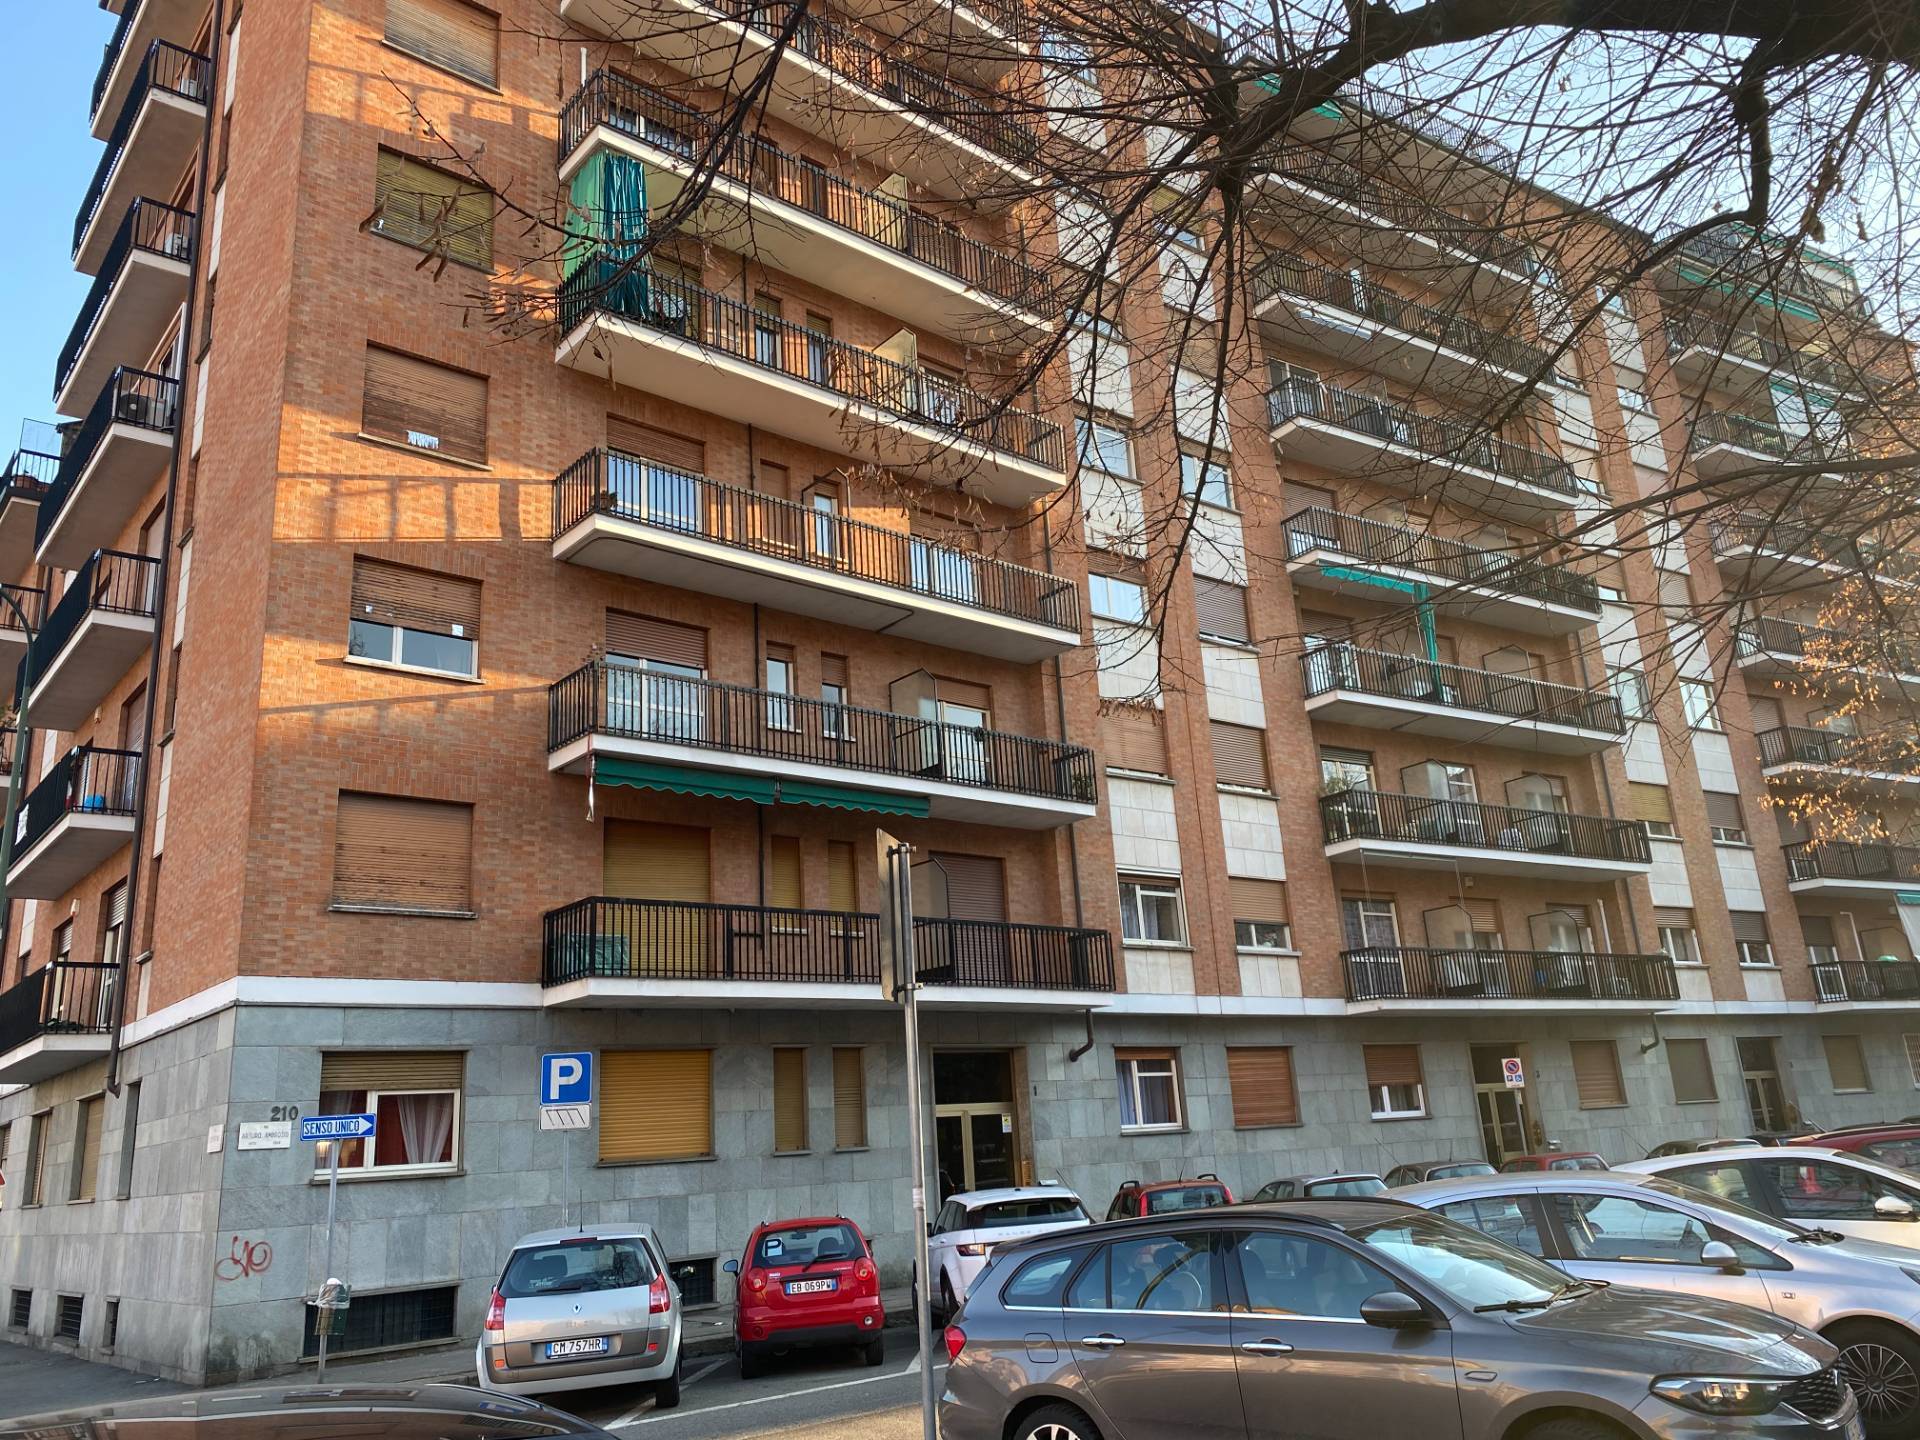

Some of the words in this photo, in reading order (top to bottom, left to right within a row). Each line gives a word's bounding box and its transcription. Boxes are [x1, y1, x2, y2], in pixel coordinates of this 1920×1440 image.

[550, 1057, 583, 1100] P
[271, 1105, 299, 1121] 210
[304, 1122, 333, 1135] SENSO
[335, 1119, 360, 1133] UNICO
[765, 1238, 782, 1257] P
[553, 1342, 566, 1354] CM
[569, 1338, 601, 1352] 757HR
